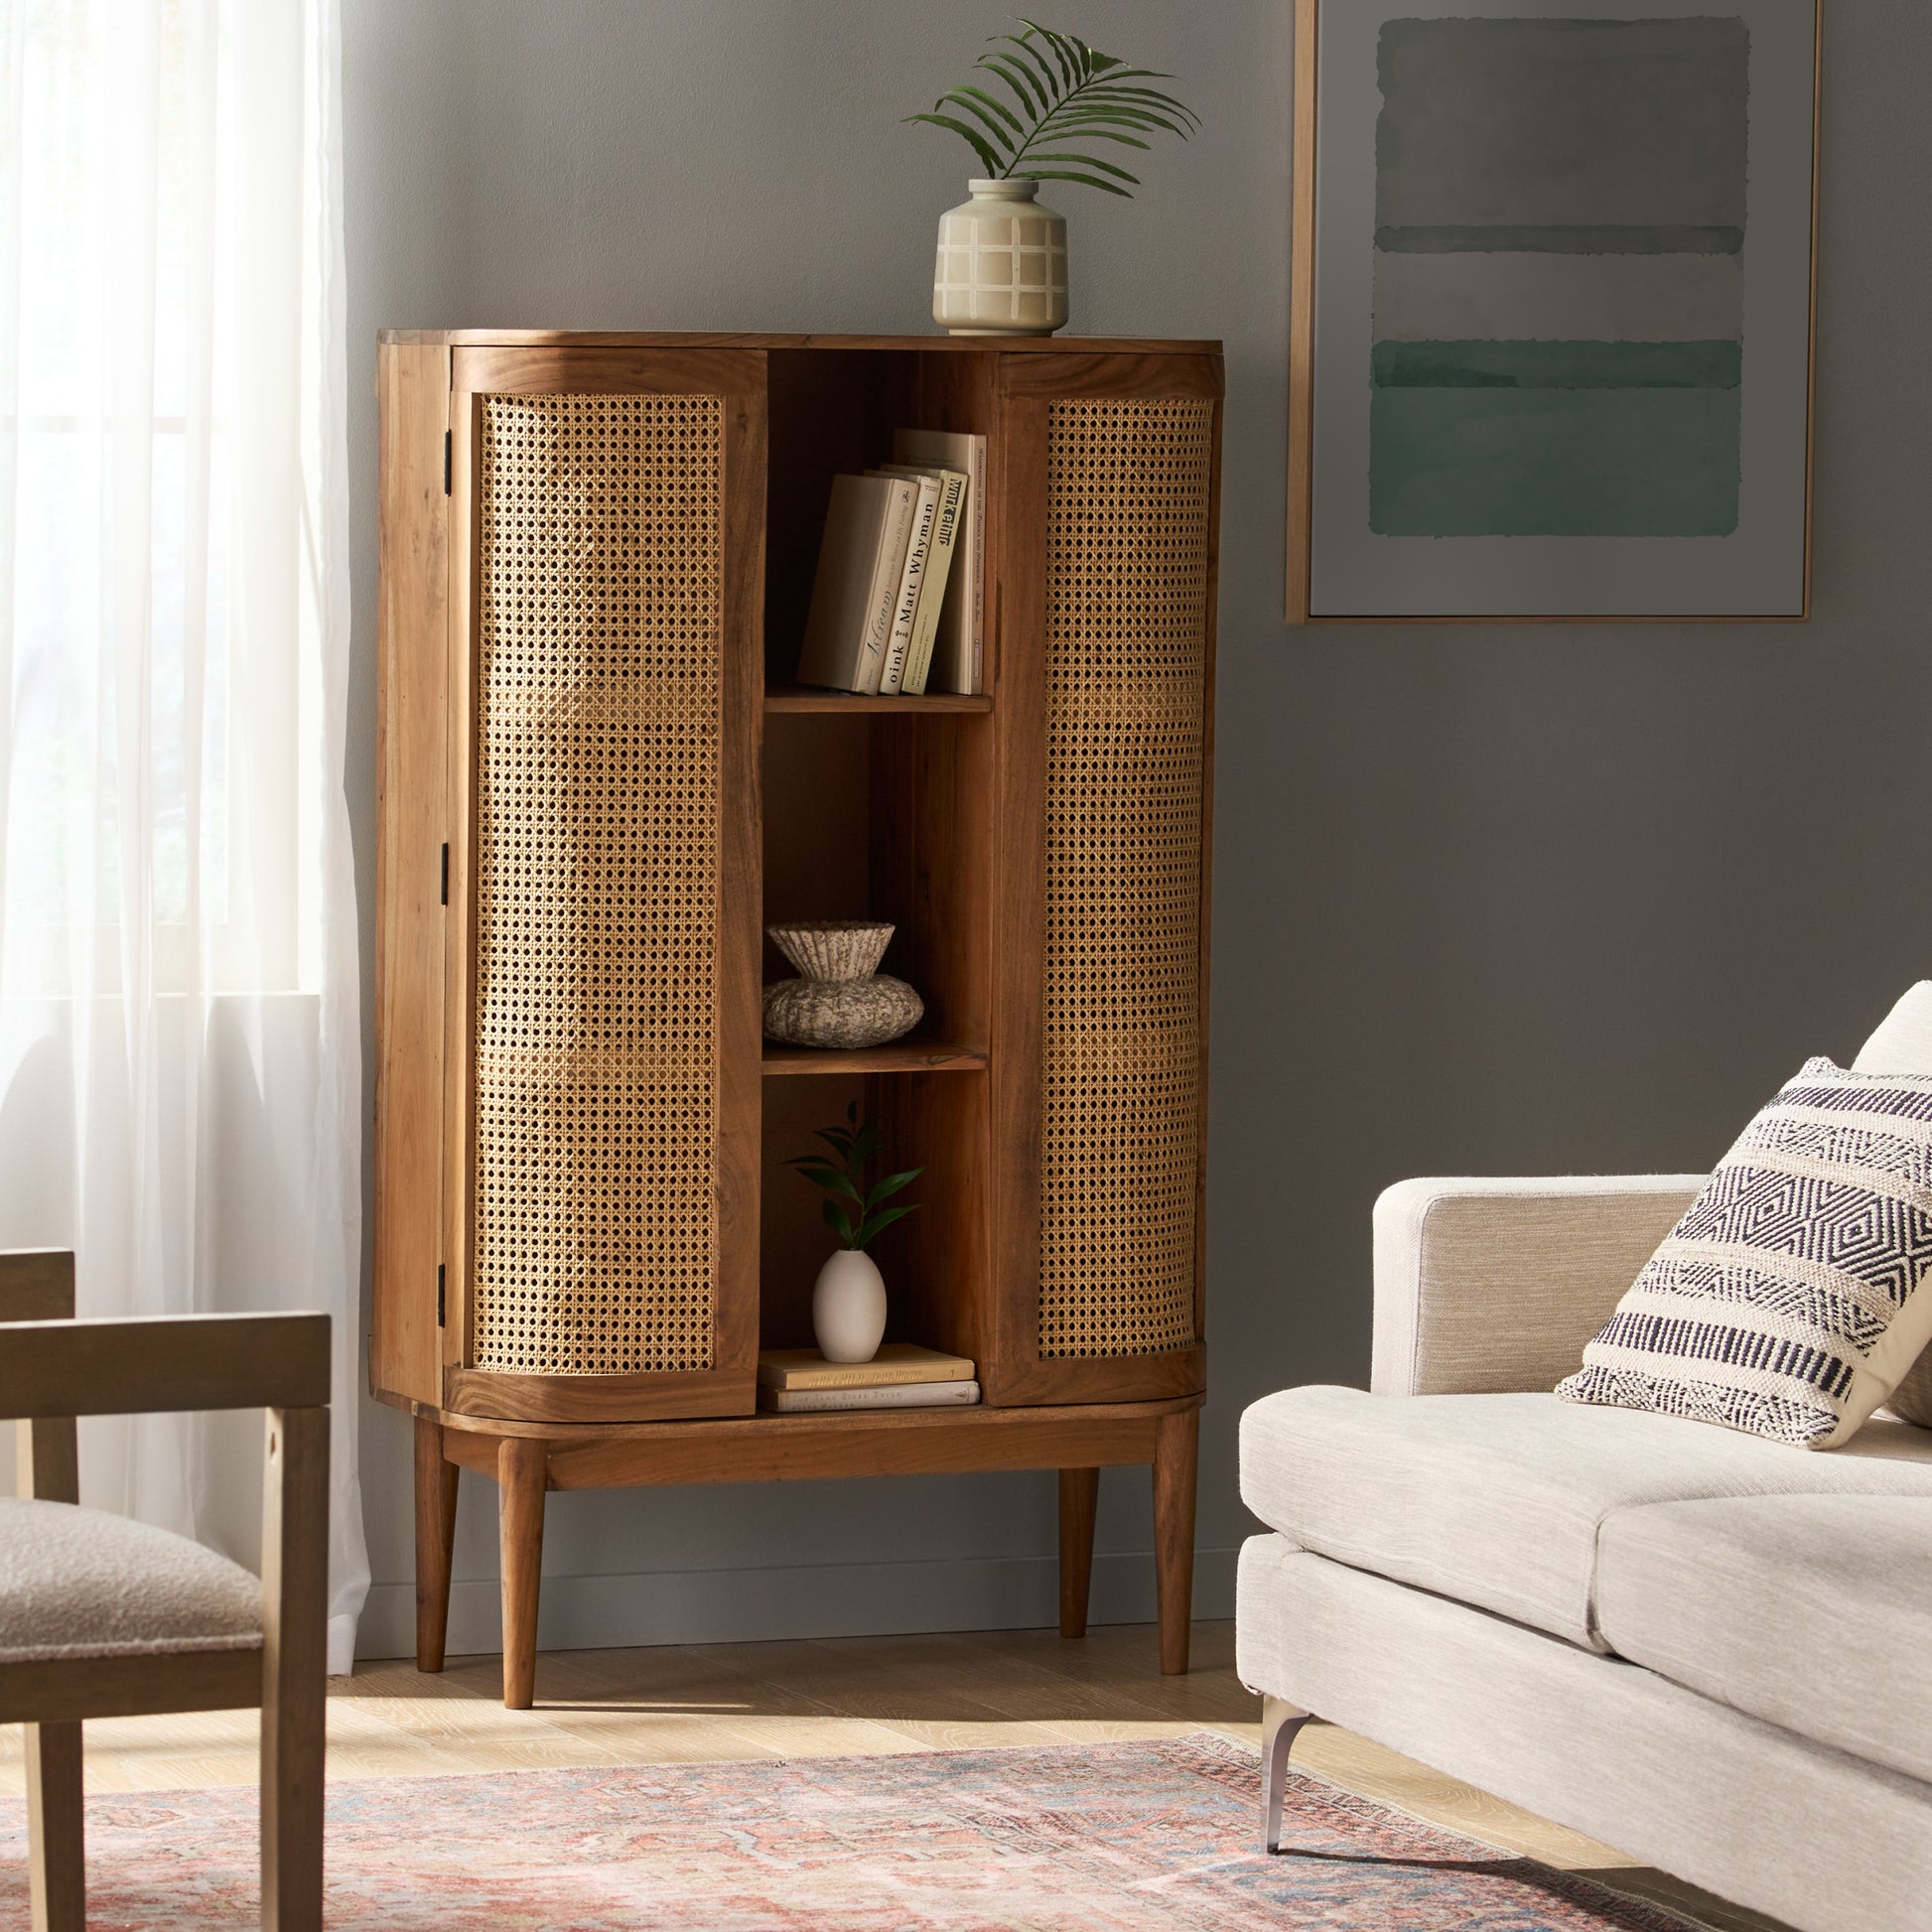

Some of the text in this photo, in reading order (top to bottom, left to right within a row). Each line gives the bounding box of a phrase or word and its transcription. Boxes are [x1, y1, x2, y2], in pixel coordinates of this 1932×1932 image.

[938, 479, 962, 547] work ethic
[890, 645, 904, 683] oink
[899, 584, 917, 623] Matt
[908, 503, 933, 575] Whyman
